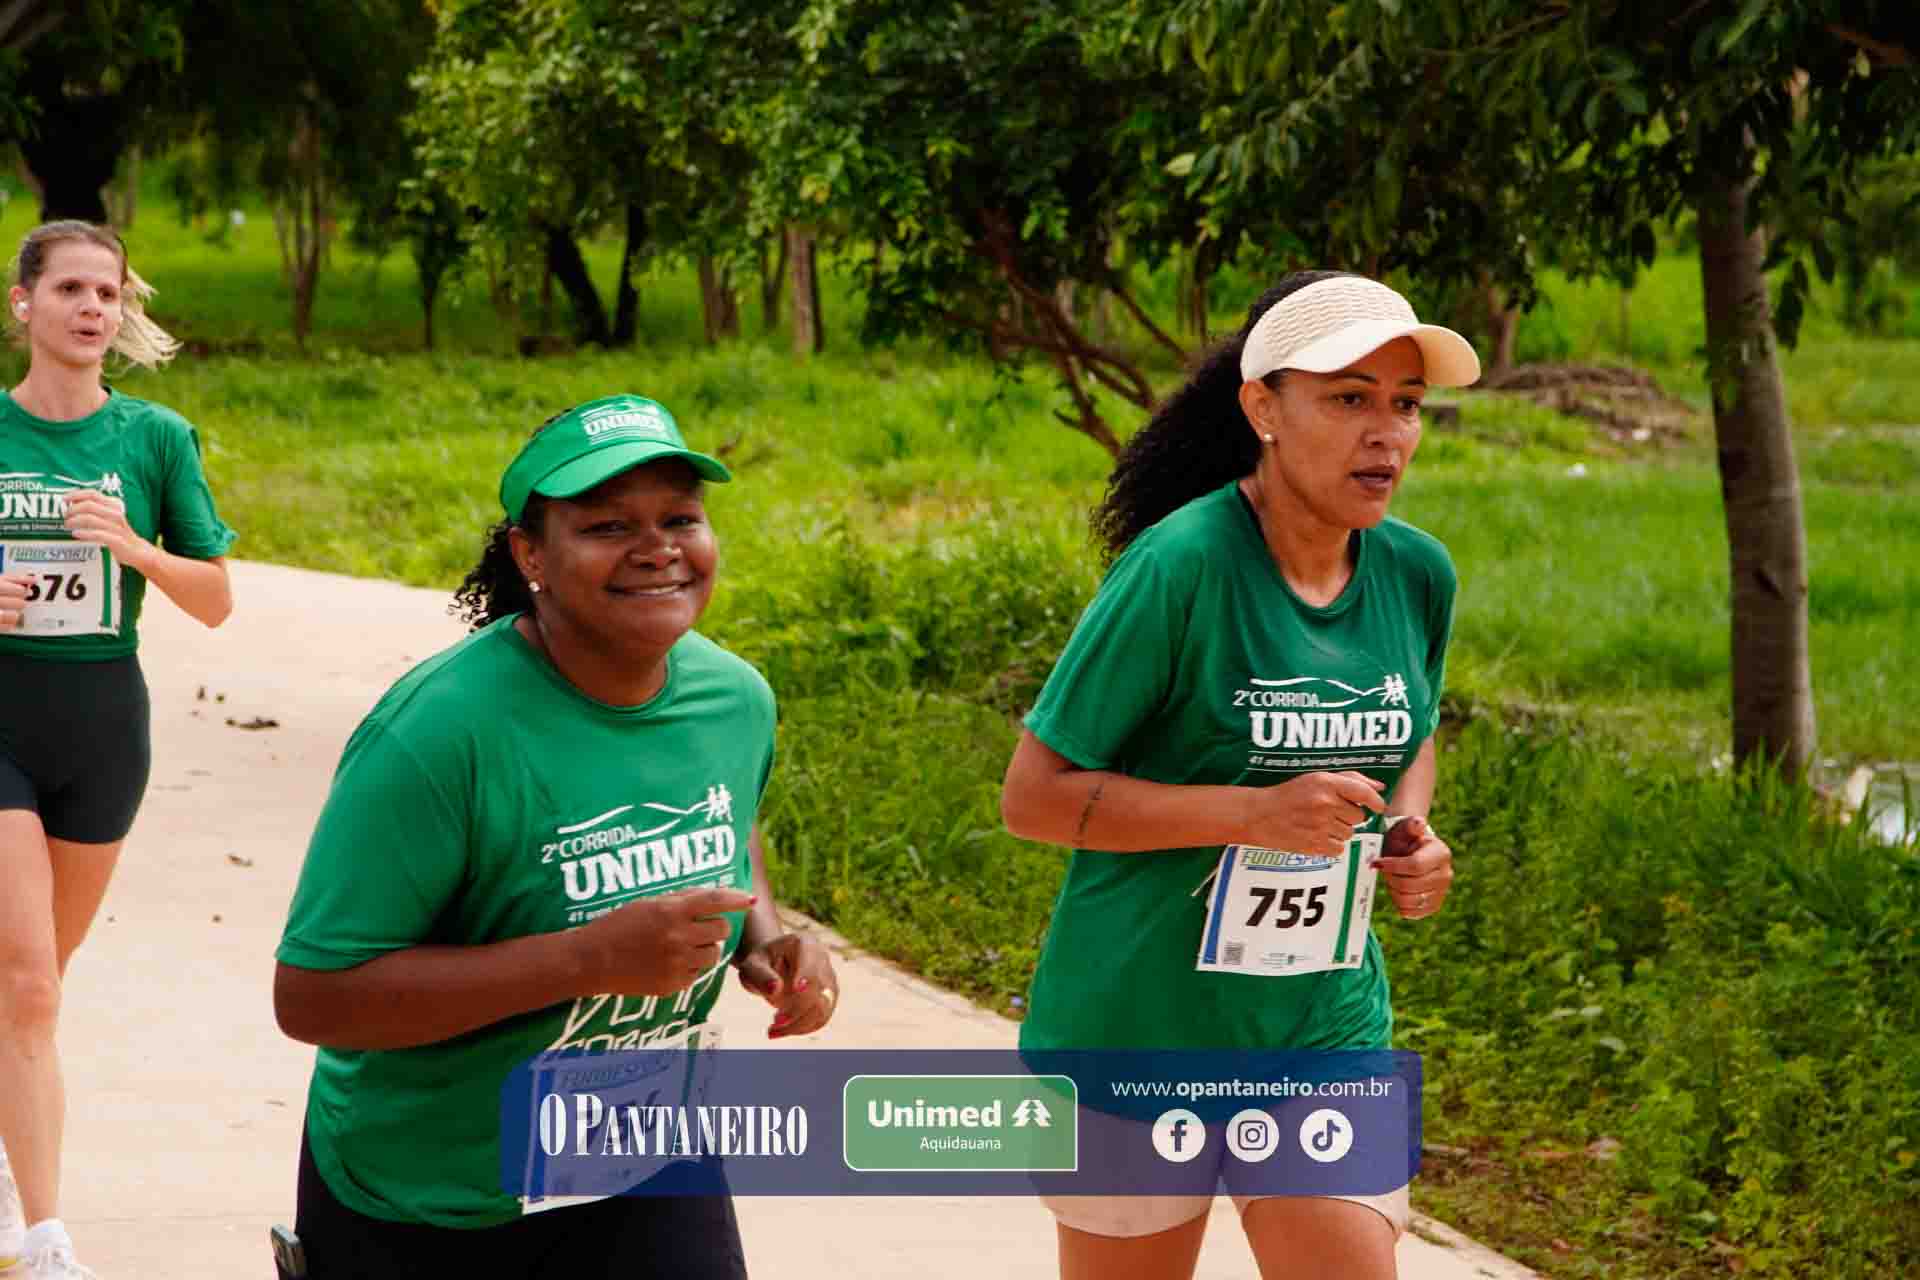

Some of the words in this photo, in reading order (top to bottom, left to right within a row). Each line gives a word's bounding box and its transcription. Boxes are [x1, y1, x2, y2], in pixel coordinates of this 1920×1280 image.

[1250, 691, 1320, 708] CORRIDA
[1249, 710, 1412, 748] UNIMED
[559, 824, 638, 858] CORRIDA
[560, 824, 736, 901] UNIMED
[1246, 886, 1328, 929] 755
